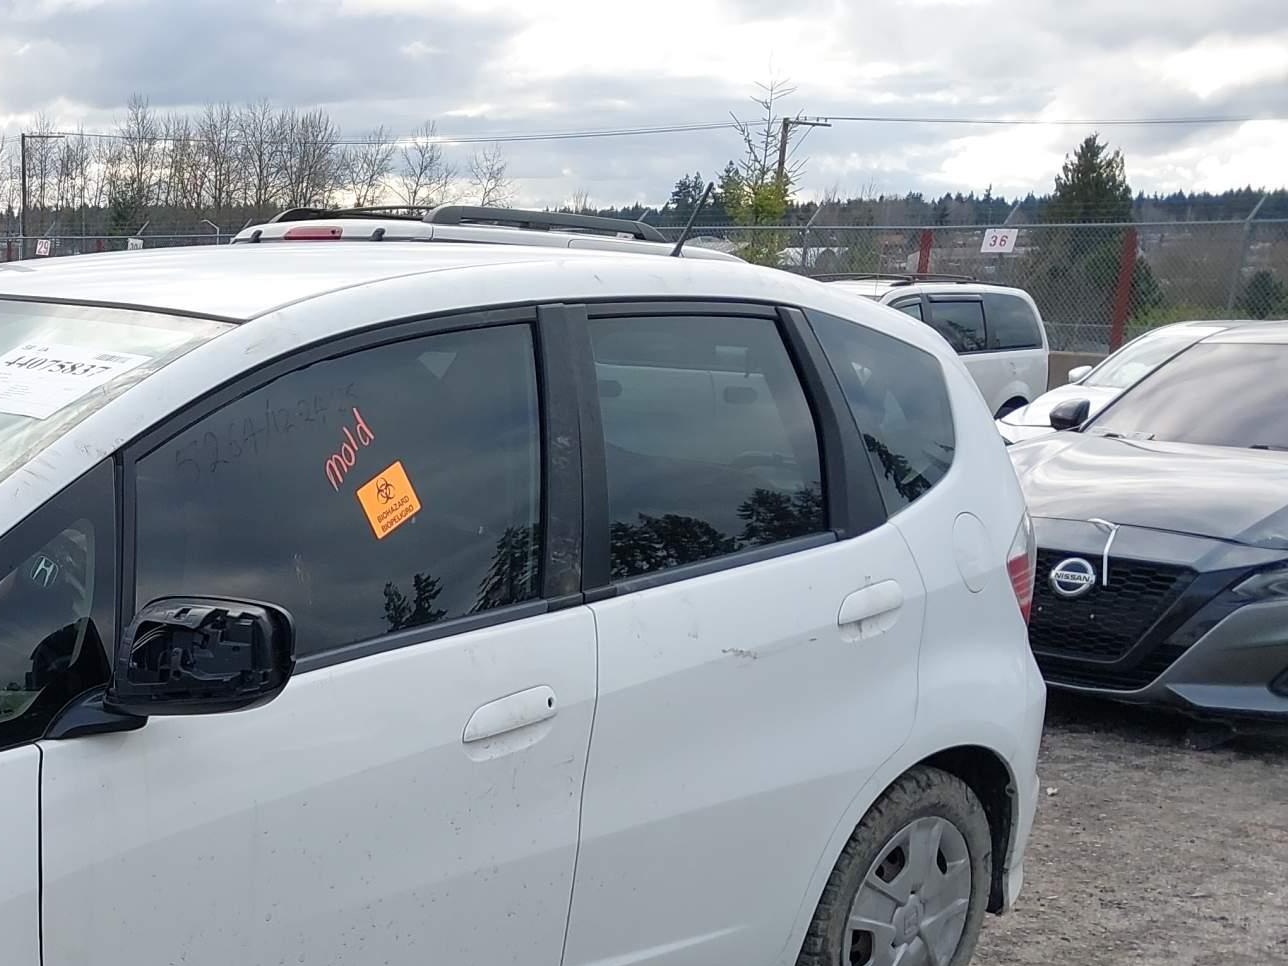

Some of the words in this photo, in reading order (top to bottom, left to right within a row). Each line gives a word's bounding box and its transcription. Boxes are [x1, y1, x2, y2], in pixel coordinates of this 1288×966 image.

[37, 240, 49, 255] 29
[989, 235, 1008, 247] 36
[5, 355, 112, 377] 44075837
[324, 406, 375, 493] mold
[376, 495, 410, 523] BIOHAZARD
[381, 504, 414, 533] BIOPELIGRO
[1054, 572, 1090, 582] NISSAN
